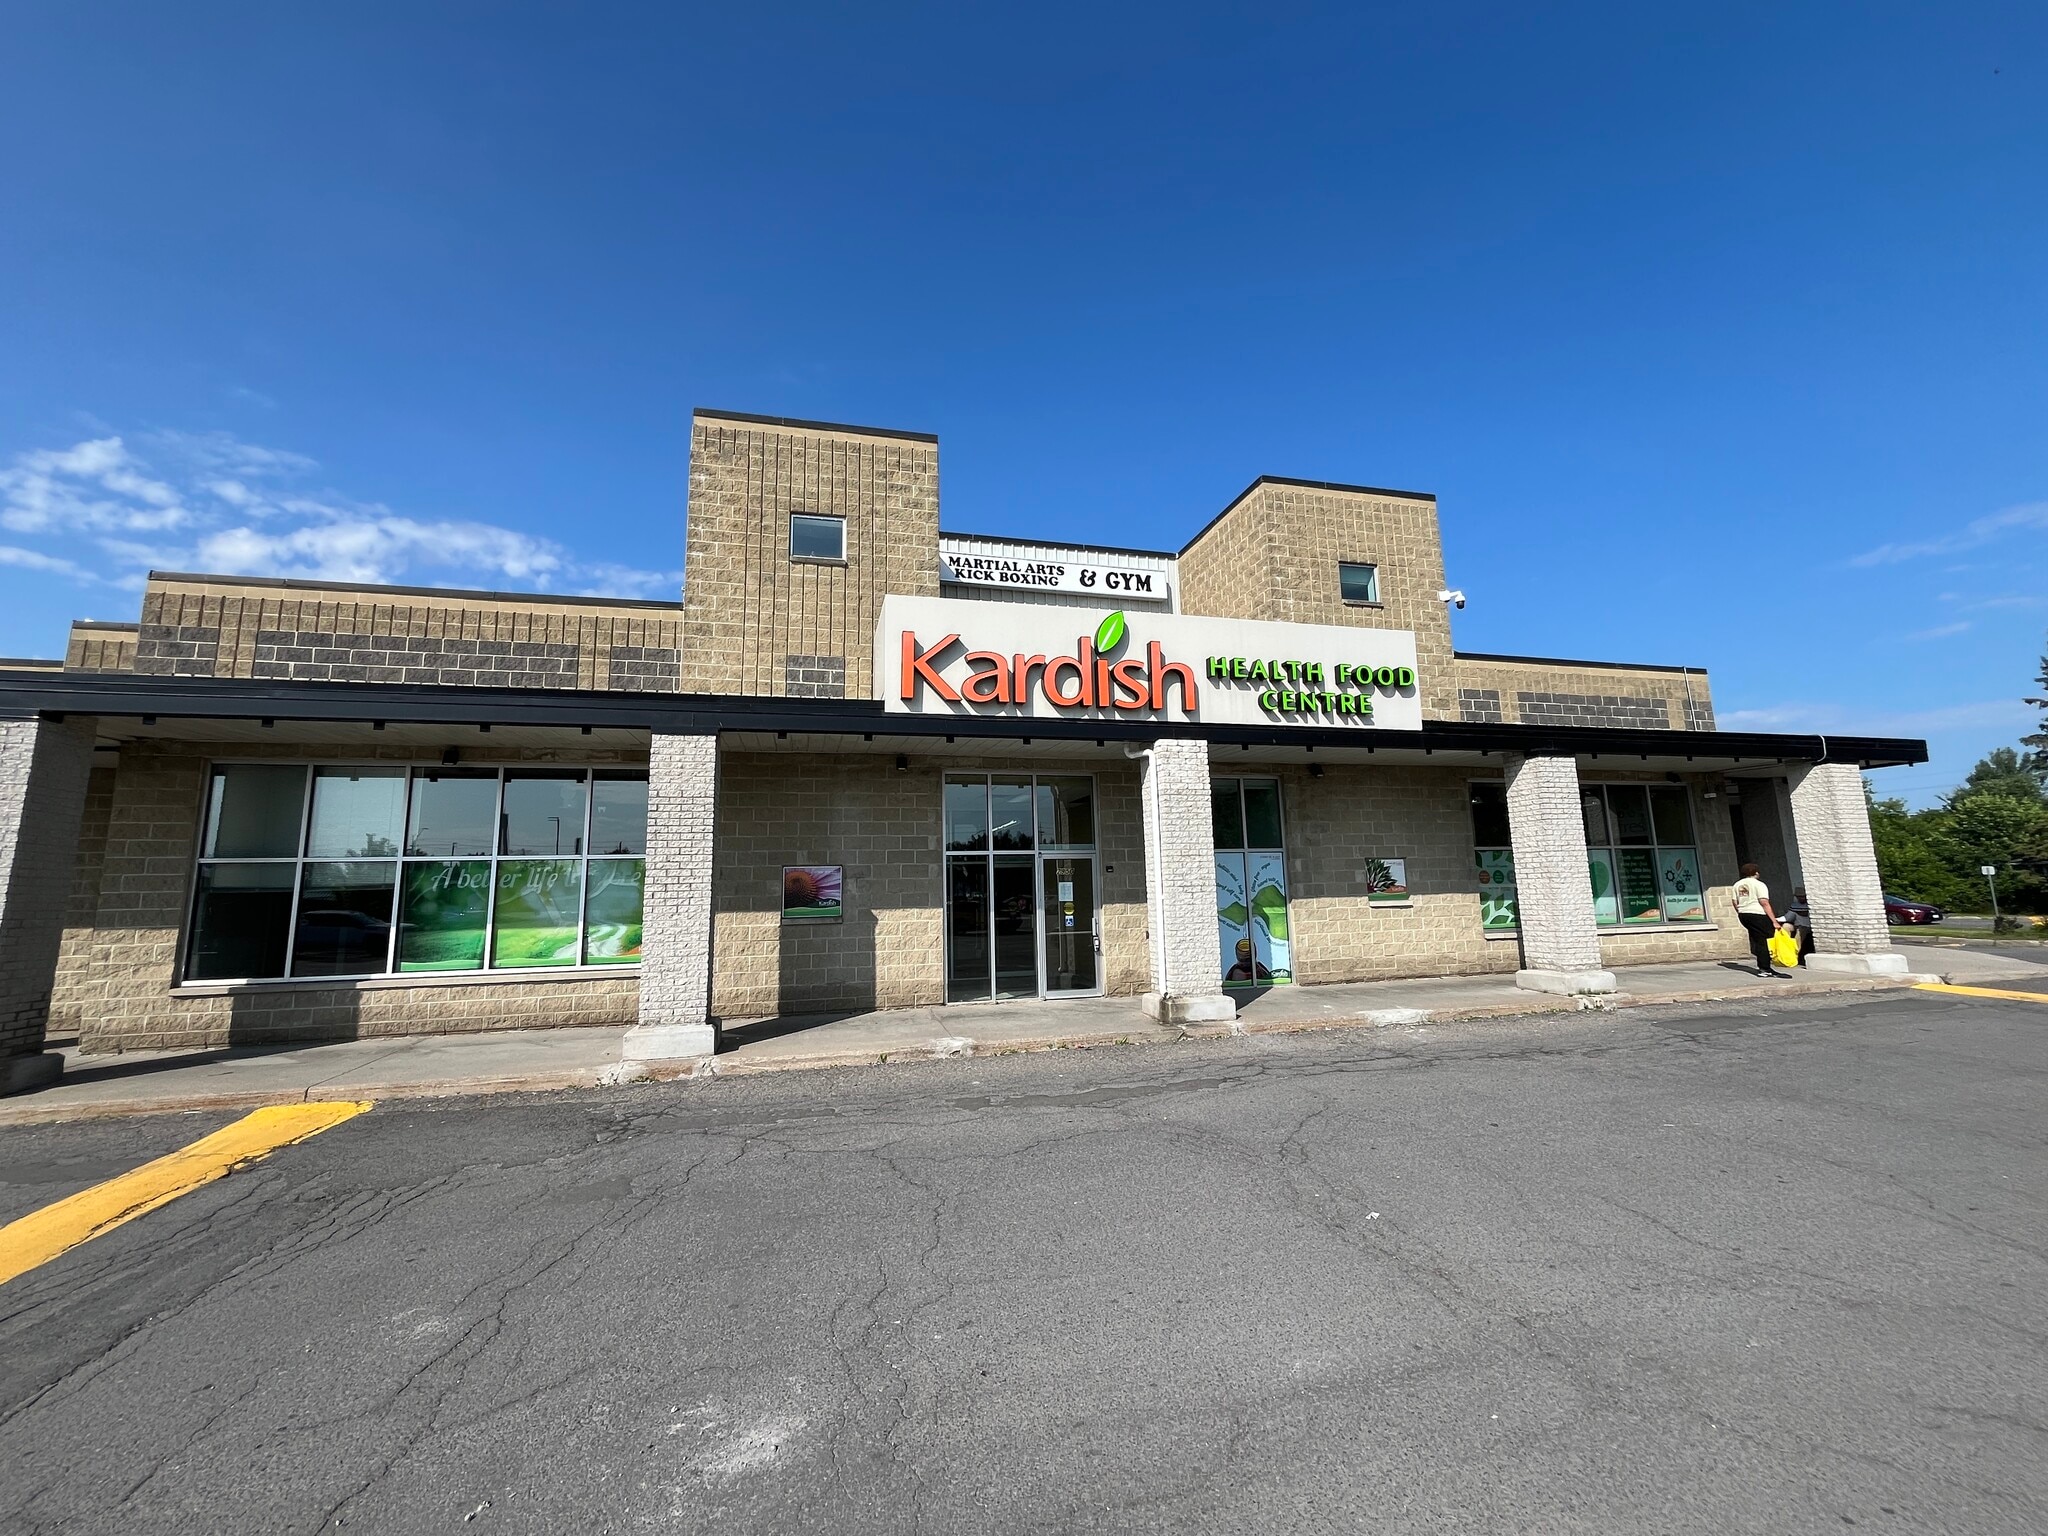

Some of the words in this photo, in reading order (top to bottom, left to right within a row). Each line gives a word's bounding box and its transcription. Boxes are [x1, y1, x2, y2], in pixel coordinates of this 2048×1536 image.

[948, 556, 1022, 572] MARTIAL
[1024, 562, 1065, 576] ARTS
[954, 568, 995, 581] KICK
[999, 571, 1059, 587] BOXING
[1079, 569, 1097, 587] &
[1105, 572, 1153, 592] GYM
[901, 630, 1197, 711] Kardish
[1206, 656, 1324, 683] HEALTH
[1335, 663, 1416, 687] FOOD
[1259, 689, 1374, 715] CENTRE
[431, 865, 454, 892] A
[458, 868, 523, 889] beter
[526, 866, 560, 893] life
